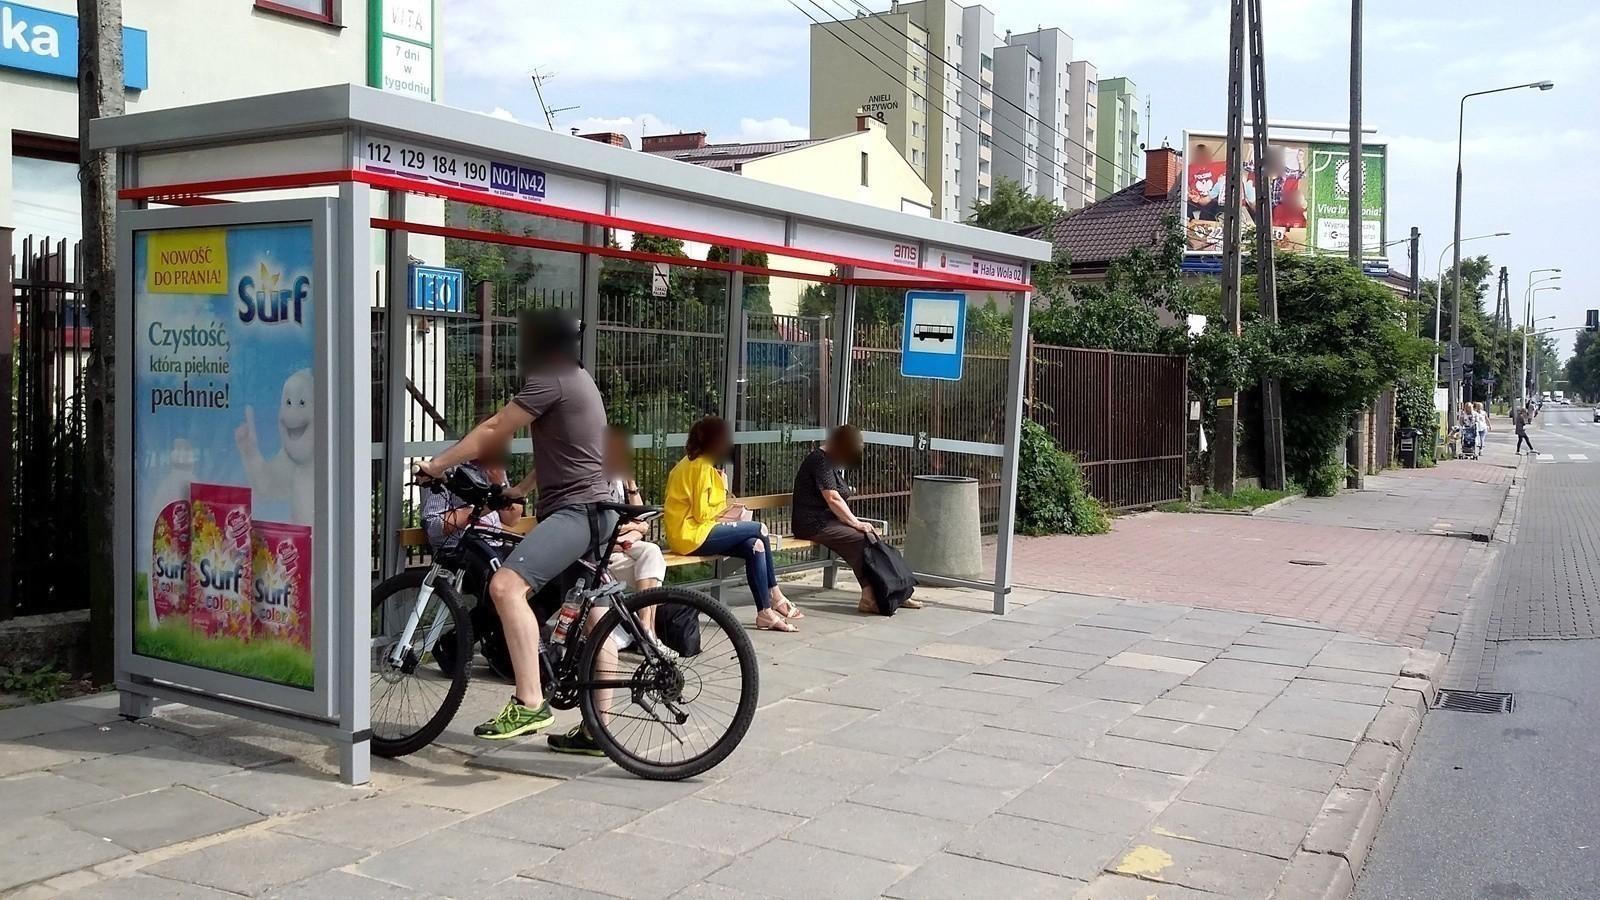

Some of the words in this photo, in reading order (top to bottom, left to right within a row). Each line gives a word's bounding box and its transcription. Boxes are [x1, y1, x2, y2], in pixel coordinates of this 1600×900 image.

[392, 7, 423, 31] VITA
[2, 6, 60, 58] ka
[395, 45, 401, 57] 7
[404, 49, 420, 61] dni
[403, 65, 412, 74] w
[385, 75, 430, 95] tygodniu
[868, 94, 891, 103] ANIELI
[367, 142, 391, 164] 112
[400, 148, 425, 170] 129
[432, 155, 457, 176] 184
[463, 161, 486, 181] 190
[492, 166, 516, 188] N01
[520, 172, 545, 193] N42
[1317, 203, 1338, 214] Viva
[161, 246, 213, 266] NOWOŚĆ
[893, 243, 917, 261] ams
[154, 271, 172, 286] DO
[174, 270, 221, 285] PRANIA!
[980, 264, 995, 278] Hala
[996, 268, 1012, 280] Wola
[1013, 270, 1021, 281] 02
[238, 275, 310, 327] Surf
[149, 320, 231, 354] Czystość,
[150, 355, 182, 374] która
[184, 356, 230, 378] pięknie
[151, 380, 230, 414] pachnie!
[156, 556, 188, 581] Surf
[200, 558, 244, 594] Surf
[206, 594, 238, 612] color
[254, 579, 292, 607] Surf
